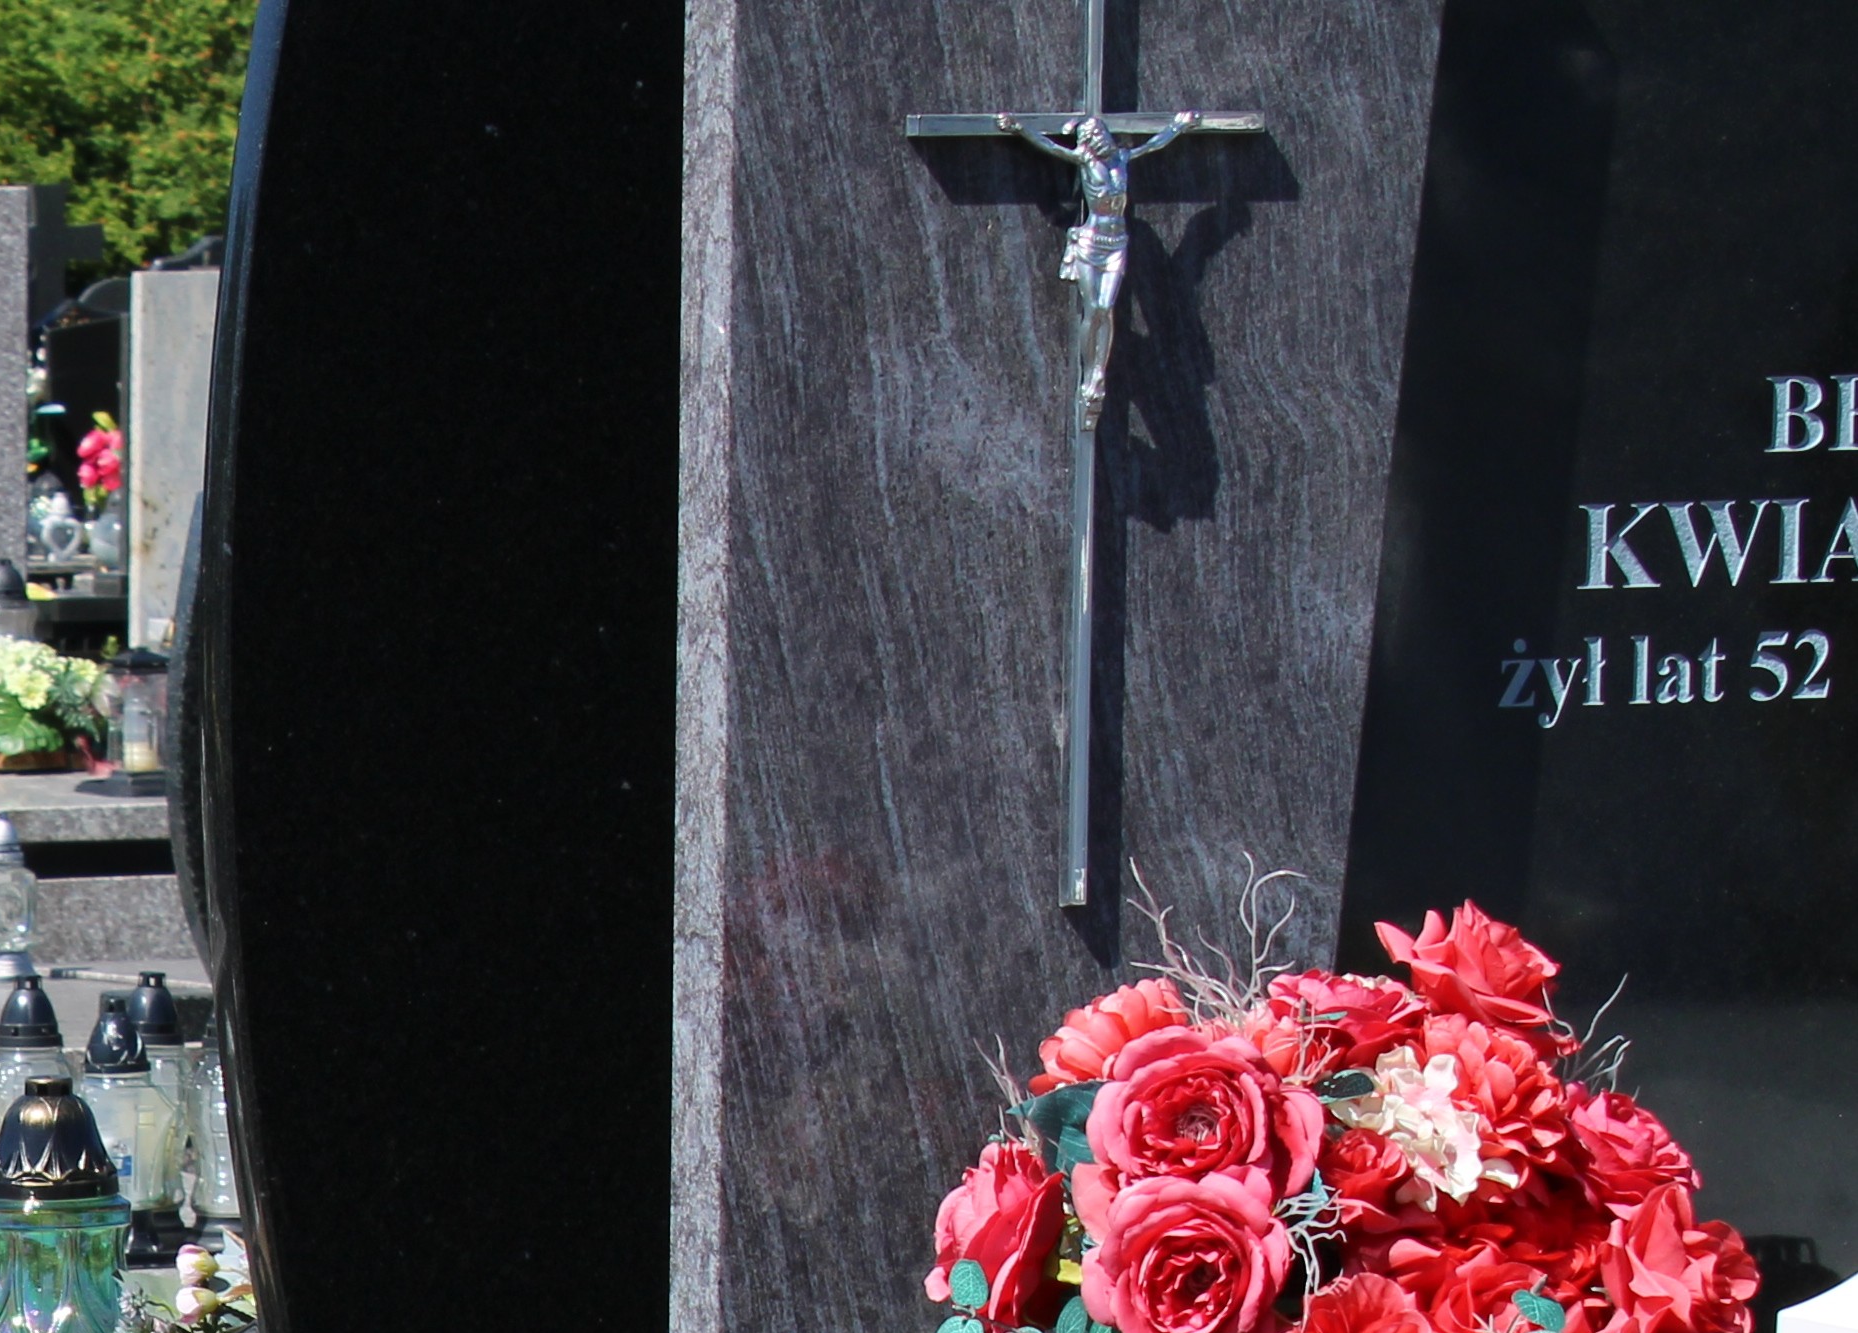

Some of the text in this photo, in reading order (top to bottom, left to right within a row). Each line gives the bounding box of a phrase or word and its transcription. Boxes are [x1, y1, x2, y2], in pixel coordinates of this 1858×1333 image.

[1498, 628, 1832, 730] żył lat 52
